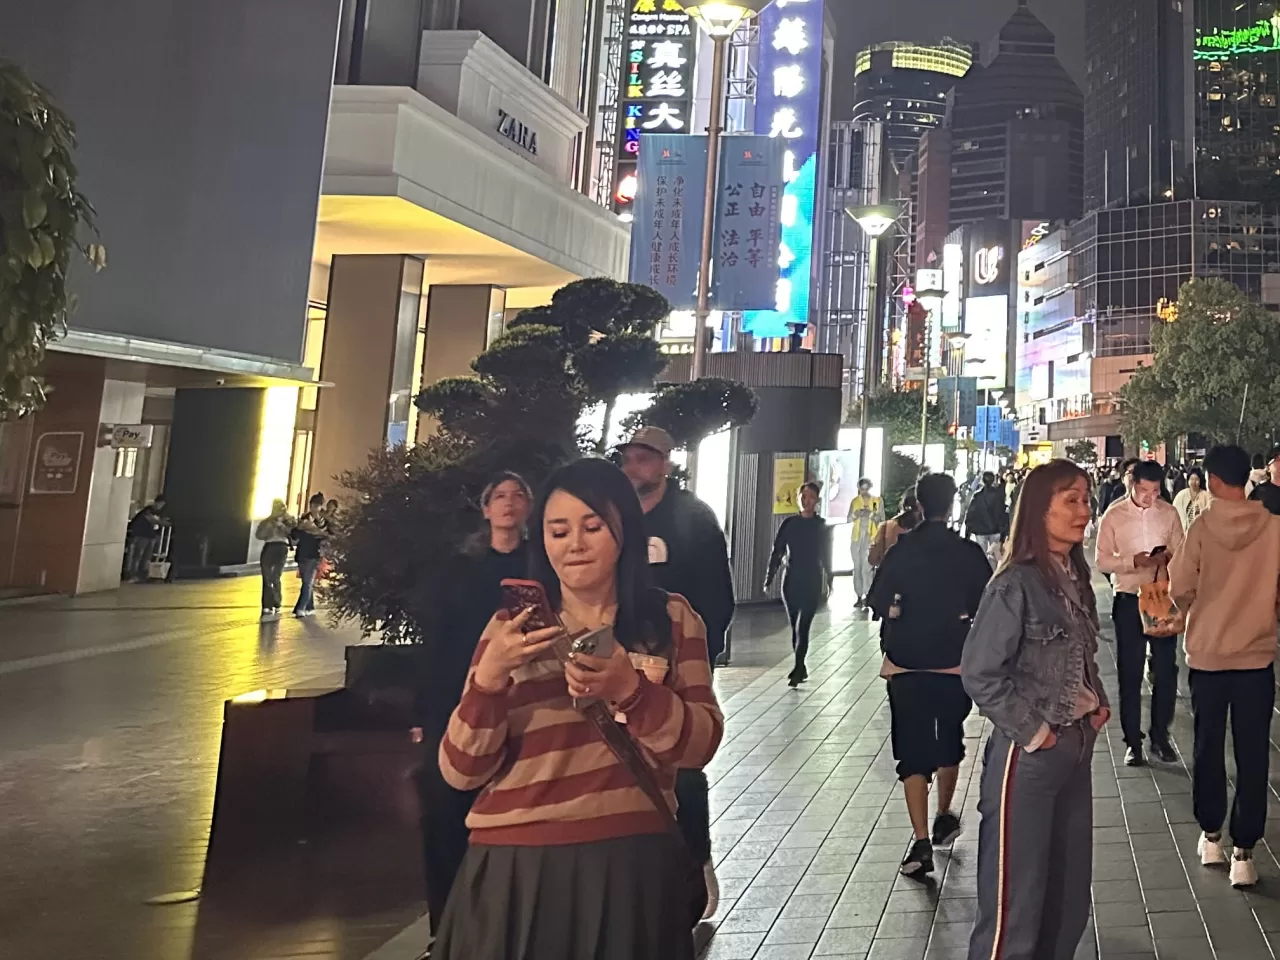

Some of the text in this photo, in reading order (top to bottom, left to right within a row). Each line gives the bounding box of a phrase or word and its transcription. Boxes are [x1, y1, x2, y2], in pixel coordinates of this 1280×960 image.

[667, 24, 690, 35] SPA
[627, 50, 644, 98] SILK
[496, 109, 538, 156] ZARA
[624, 105, 642, 153] KING
[724, 182, 743, 217] 公正
[748, 182, 766, 217] 自由
